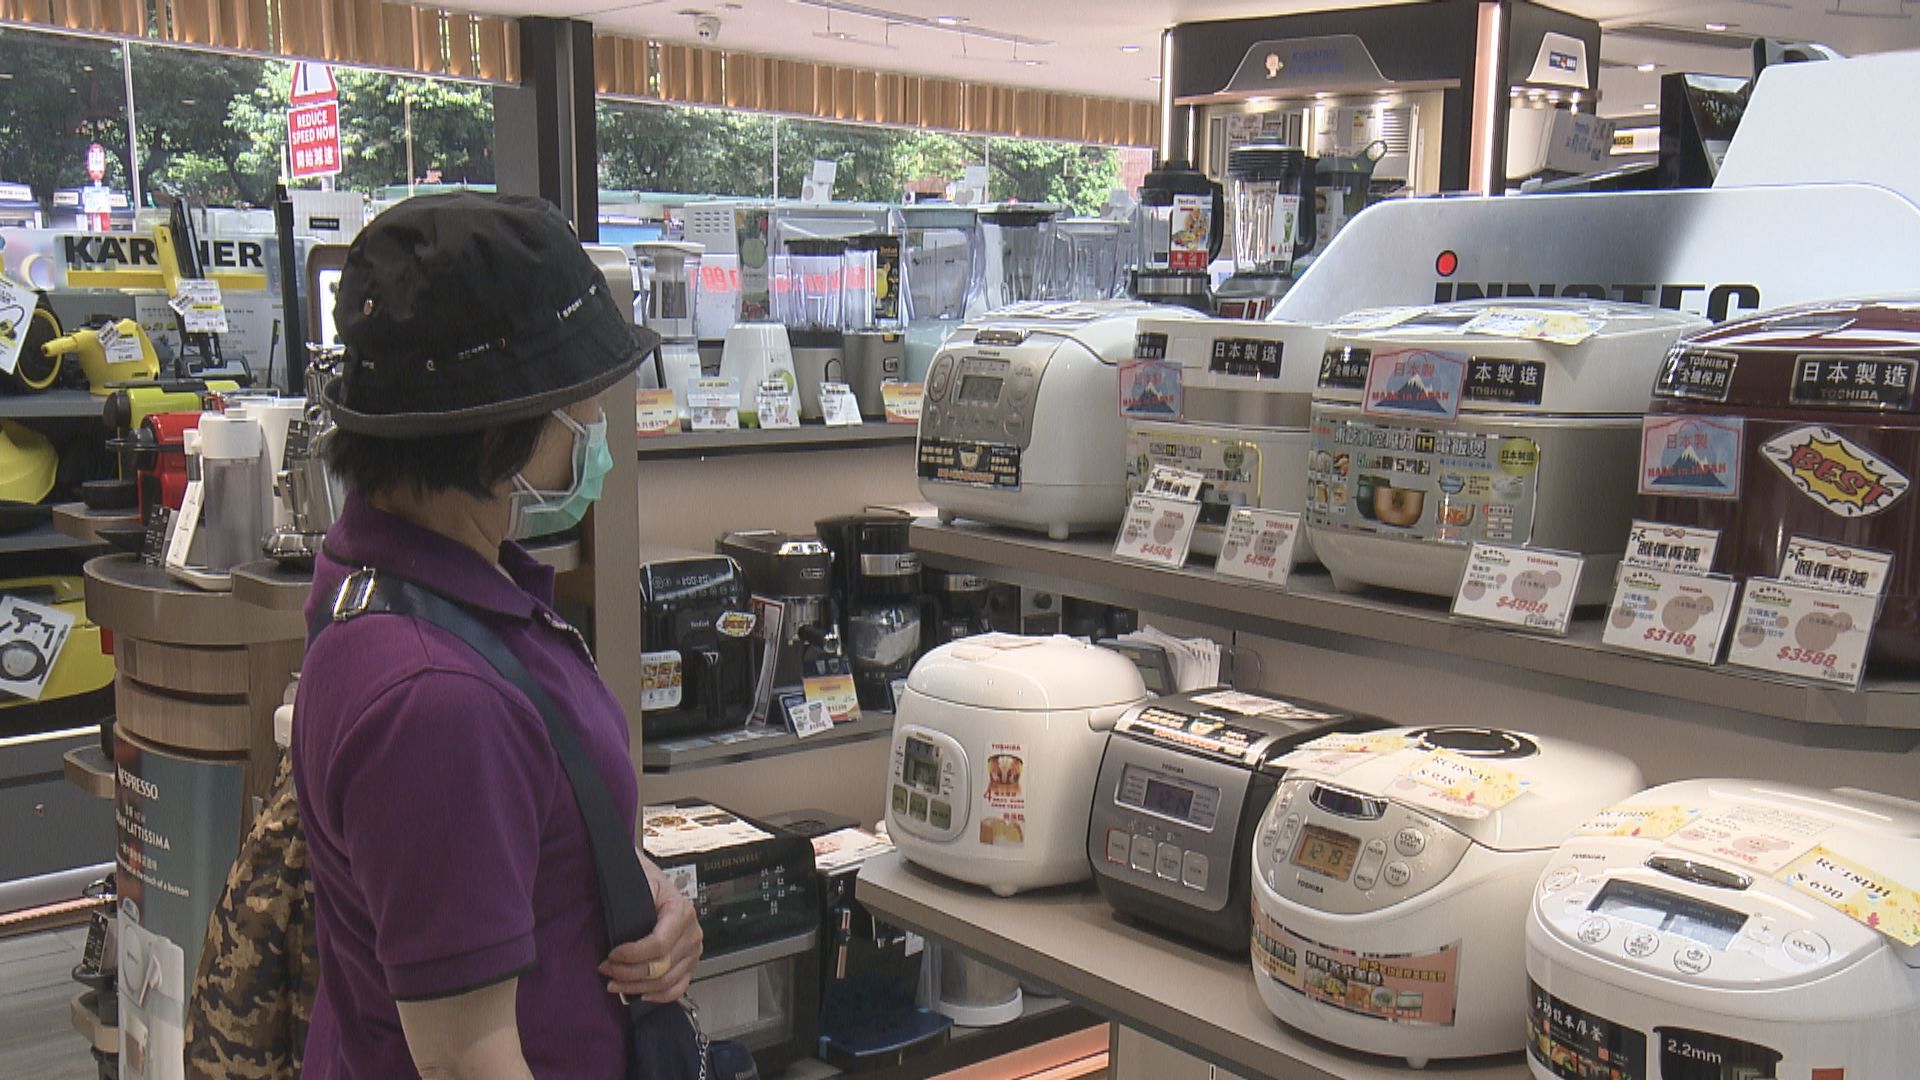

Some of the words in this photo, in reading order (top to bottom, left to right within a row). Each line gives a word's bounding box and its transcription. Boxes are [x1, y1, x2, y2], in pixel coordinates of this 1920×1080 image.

[296, 110, 328, 128] REDUCE
[292, 130, 315, 145] SPEED
[317, 125, 335, 140] NOW
[64, 236, 264, 267] KÄRER
[1215, 341, 1277, 363] 日本製造
[1689, 357, 1729, 369] TOSHIBA
[1680, 368, 1725, 387] 全機保用
[1802, 361, 1908, 388] 日本製造
[1821, 388, 1879, 400] TOSHIBA
[1666, 433, 1708, 449] 日本製
[1790, 444, 1895, 507] BEST
[1643, 628, 1696, 647] $3188
[1777, 646, 1837, 667] $3588
[117, 762, 158, 800] NESPRESSO
[127, 819, 170, 851] LATTISSIMA
[1297, 879, 1324, 894] TOSHIBA
[1668, 1038, 1722, 1064] 2.2mm
